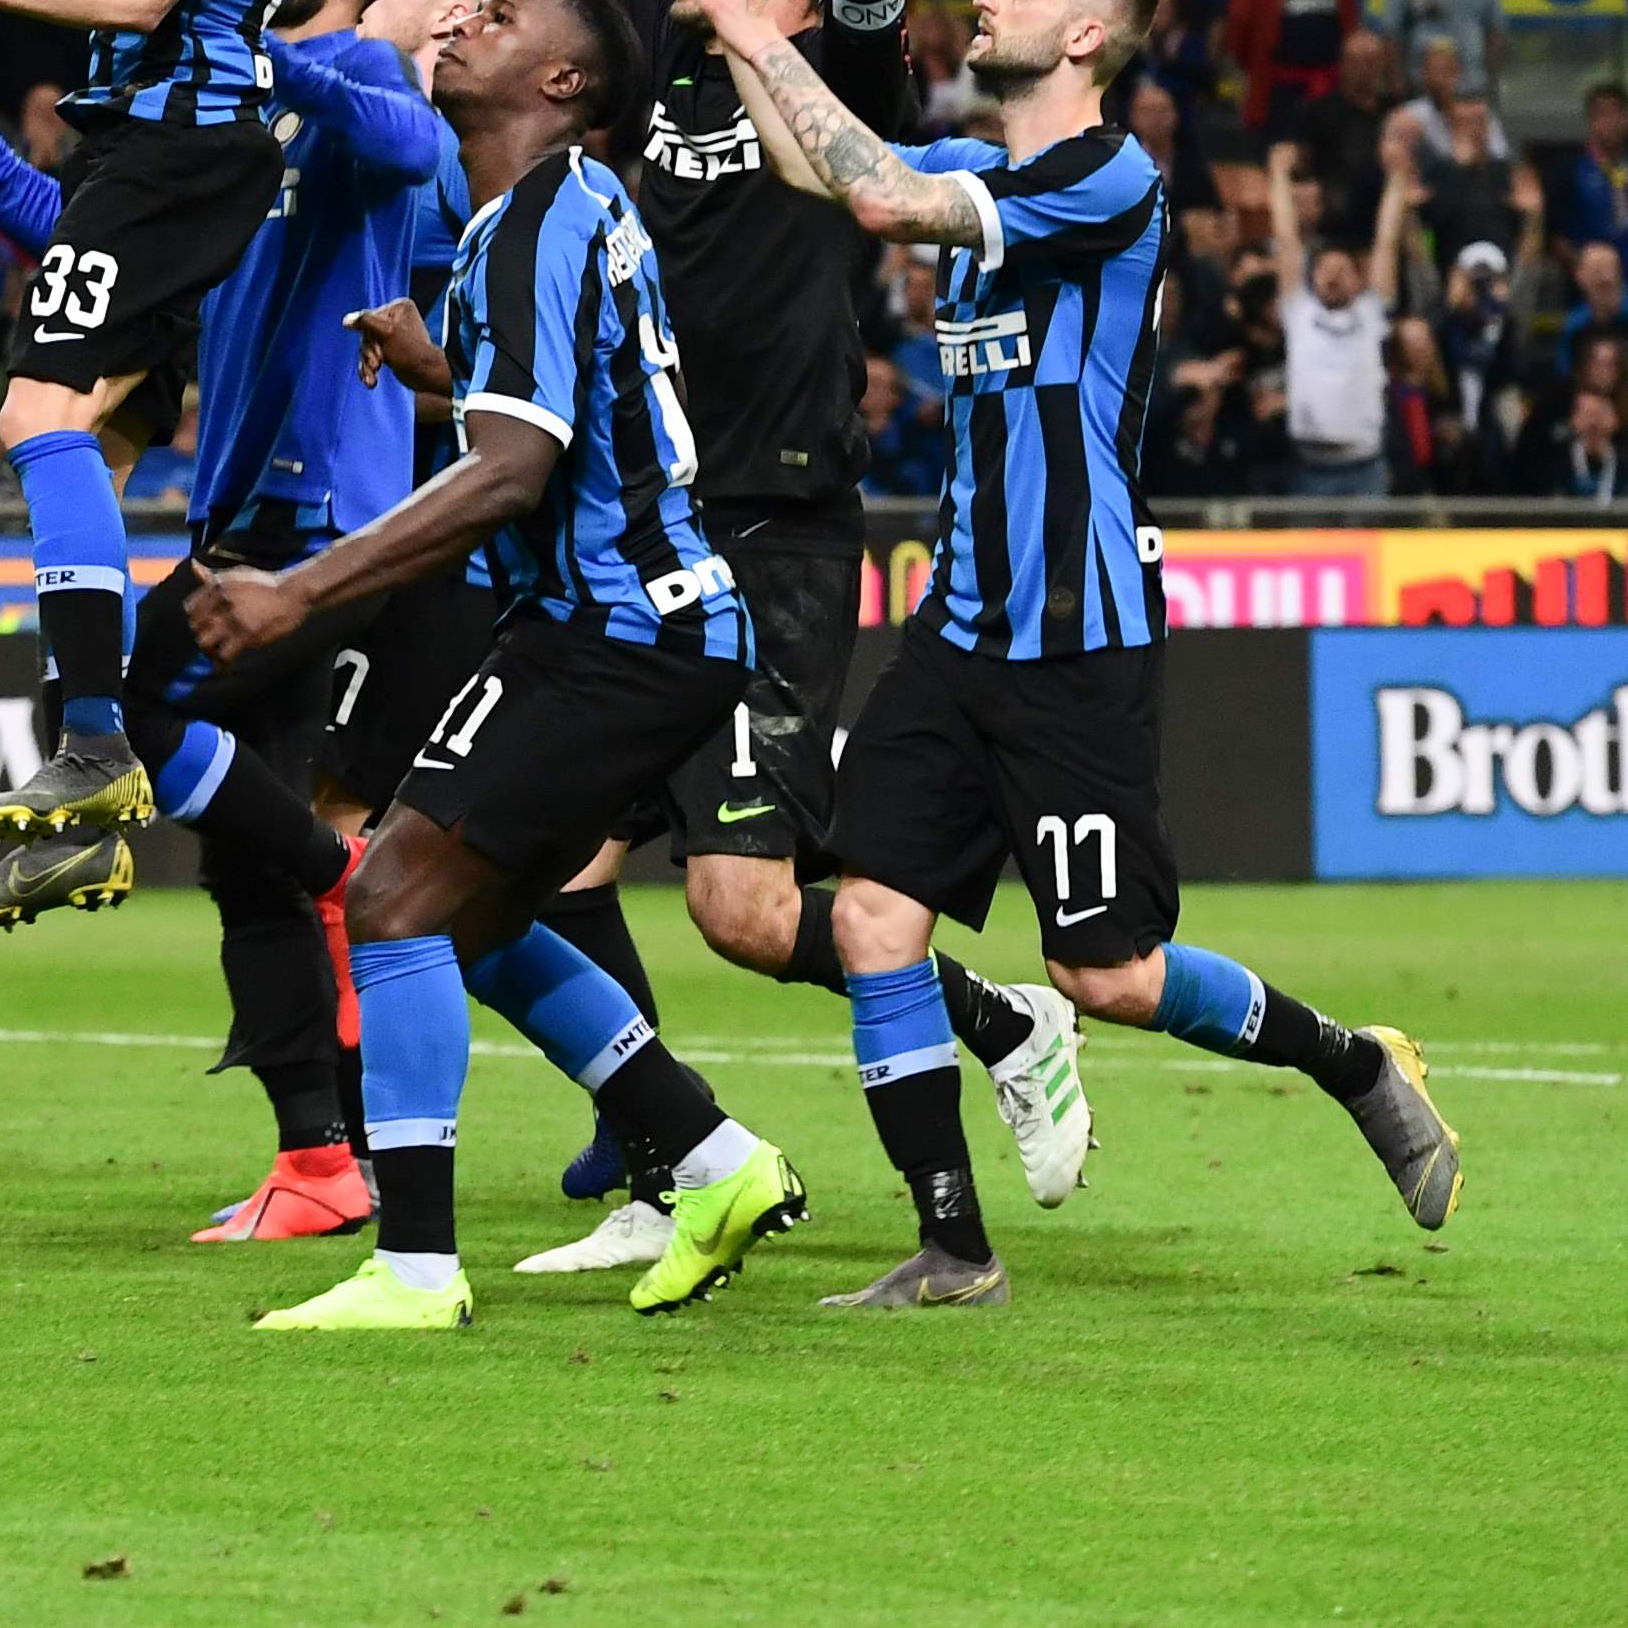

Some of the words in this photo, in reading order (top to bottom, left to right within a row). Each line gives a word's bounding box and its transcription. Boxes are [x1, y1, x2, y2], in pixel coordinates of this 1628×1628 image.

[31, 243, 119, 329] 33
[935, 311, 1032, 376] PRELLI
[35, 570, 77, 587] TER
[325, 648, 370, 732] 7
[1375, 684, 1628, 816] Brot
[1037, 814, 1116, 899] 77
[612, 1019, 650, 1057] INTE
[858, 1064, 894, 1083] TER
